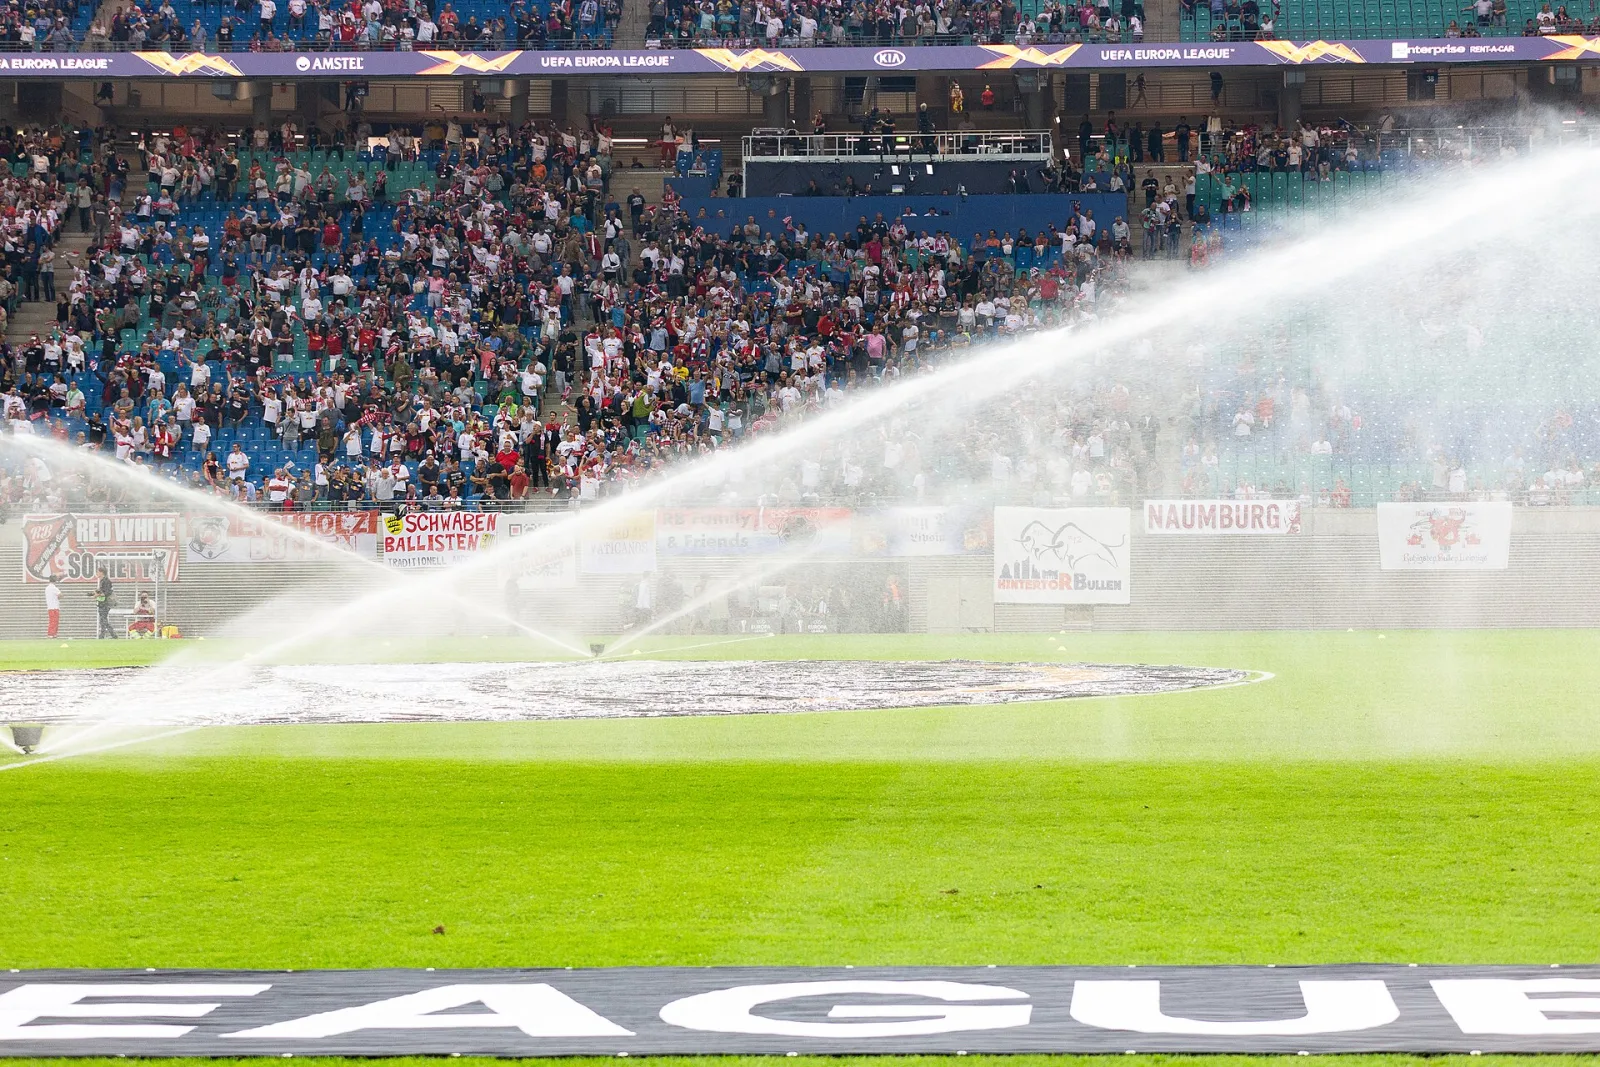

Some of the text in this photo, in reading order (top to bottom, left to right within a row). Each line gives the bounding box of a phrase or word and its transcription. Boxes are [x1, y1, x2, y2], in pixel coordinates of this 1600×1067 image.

[1101, 50, 1132, 60] UEFA
[1135, 49, 1181, 60] EUROPA
[1470, 45, 1514, 54] RENT-A-CAR
[11, 58, 58, 69] EUROPA
[541, 57, 572, 67] UEFA
[575, 56, 621, 66] EUROPA
[879, 53, 901, 63] KIA
[405, 512, 497, 533] SCHWABEN
[1148, 503, 1280, 530] NAUMBURG
[76, 518, 176, 542] RED WHITE
[385, 533, 480, 553] BALLISTEN
[667, 532, 749, 549] & Friends
[387, 555, 447, 568] TRADITIONELL
